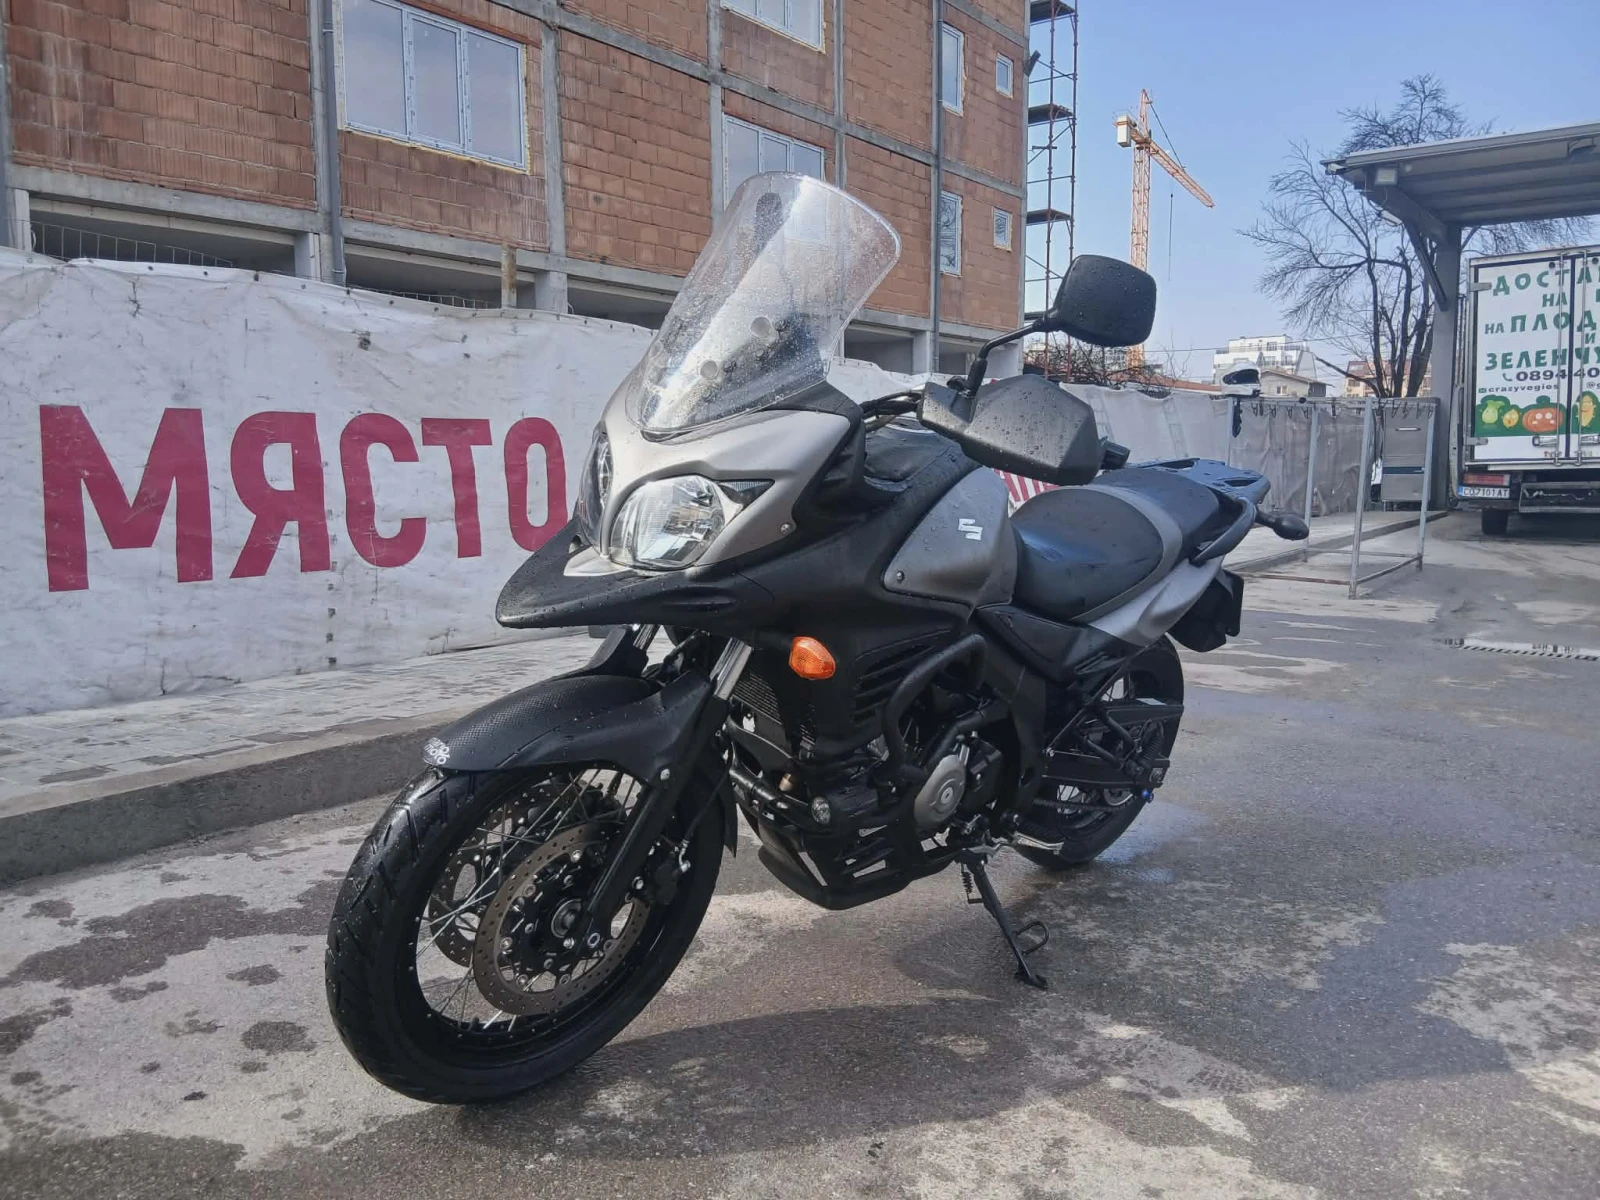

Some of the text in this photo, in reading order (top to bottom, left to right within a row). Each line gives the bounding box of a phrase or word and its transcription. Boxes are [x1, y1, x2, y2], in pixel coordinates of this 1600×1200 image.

[1493, 266, 1600, 296] ДОСТА
[1542, 292, 1568, 307] НА
[1485, 322, 1505, 334] НА
[1516, 369, 1567, 382] 0894
[40, 405, 569, 592] МЯСТО
